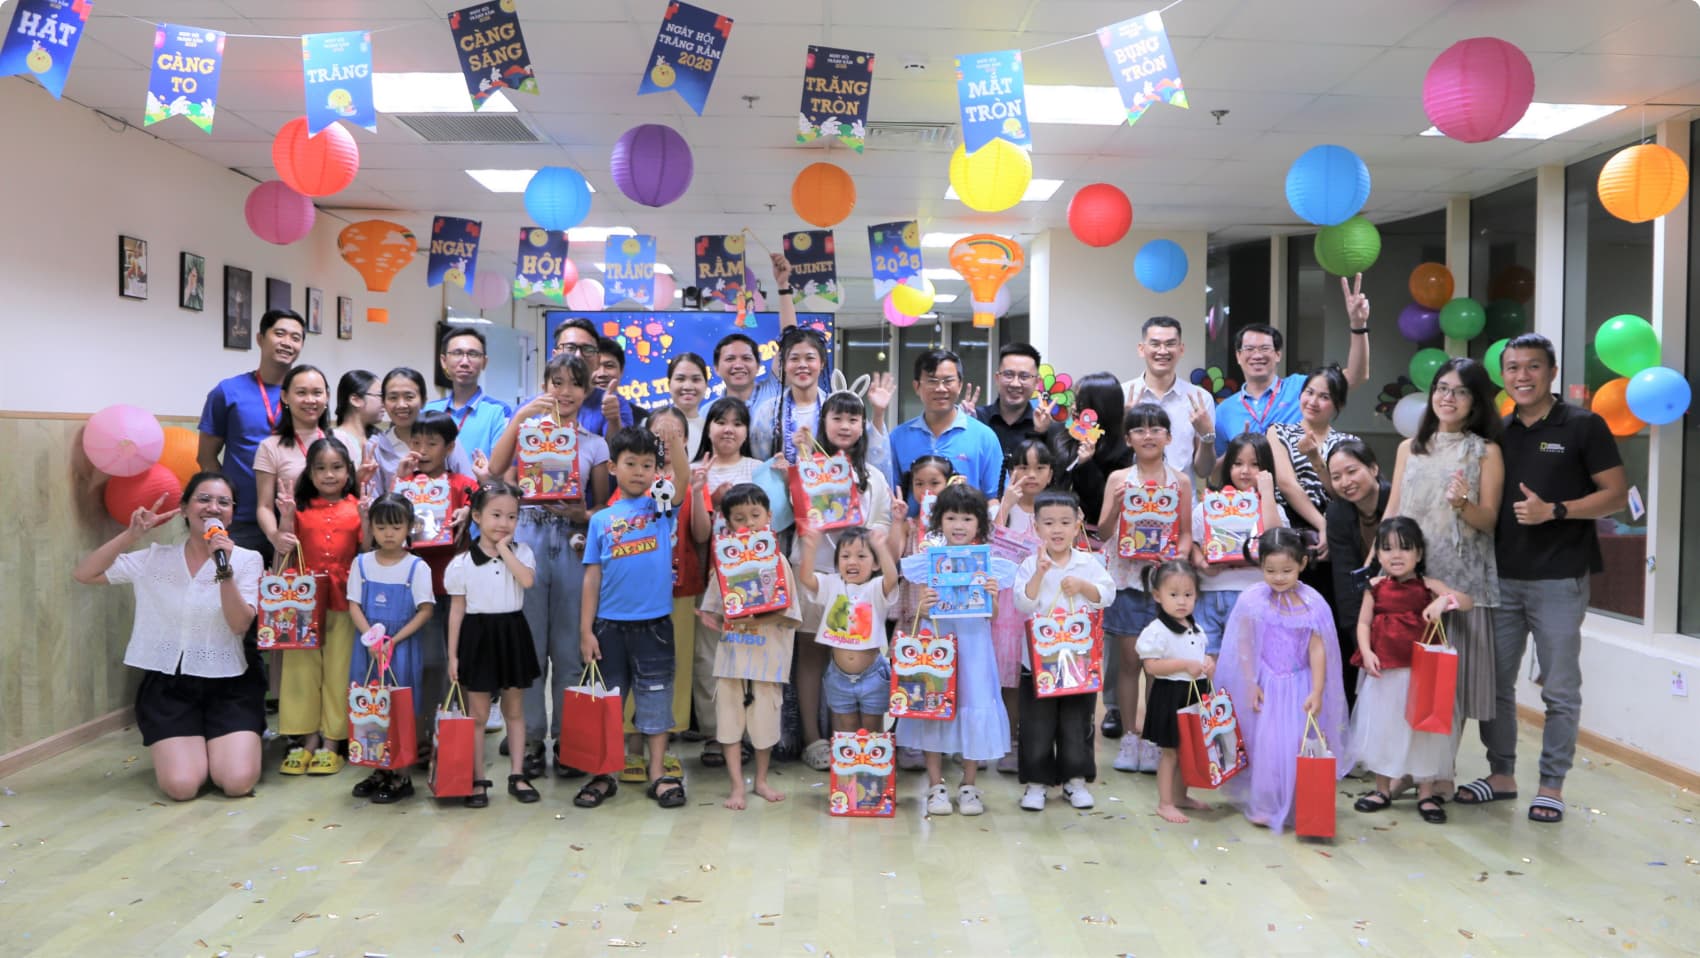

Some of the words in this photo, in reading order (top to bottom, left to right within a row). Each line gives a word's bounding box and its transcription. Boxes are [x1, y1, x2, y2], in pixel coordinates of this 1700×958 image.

[17, 9, 78, 47] HÁT
[460, 22, 516, 52] CÀNG
[468, 42, 523, 72] SÁNG
[1112, 36, 1161, 65] BỤNG
[157, 51, 216, 75] CÀNG
[306, 63, 369, 84] TRĂNG
[1120, 54, 1167, 82] TRÒN
[171, 76, 198, 94] TO
[805, 75, 869, 97] TRĂNG
[967, 72, 1013, 99] MẮT
[810, 95, 860, 116] TRÒN
[965, 97, 1022, 123] TRÒN
[431, 238, 477, 258] NGÀY
[522, 252, 562, 280] HỘI
[605, 259, 655, 280] TRĂNG
[699, 256, 744, 279] RẰM
[875, 252, 921, 273] 2025
